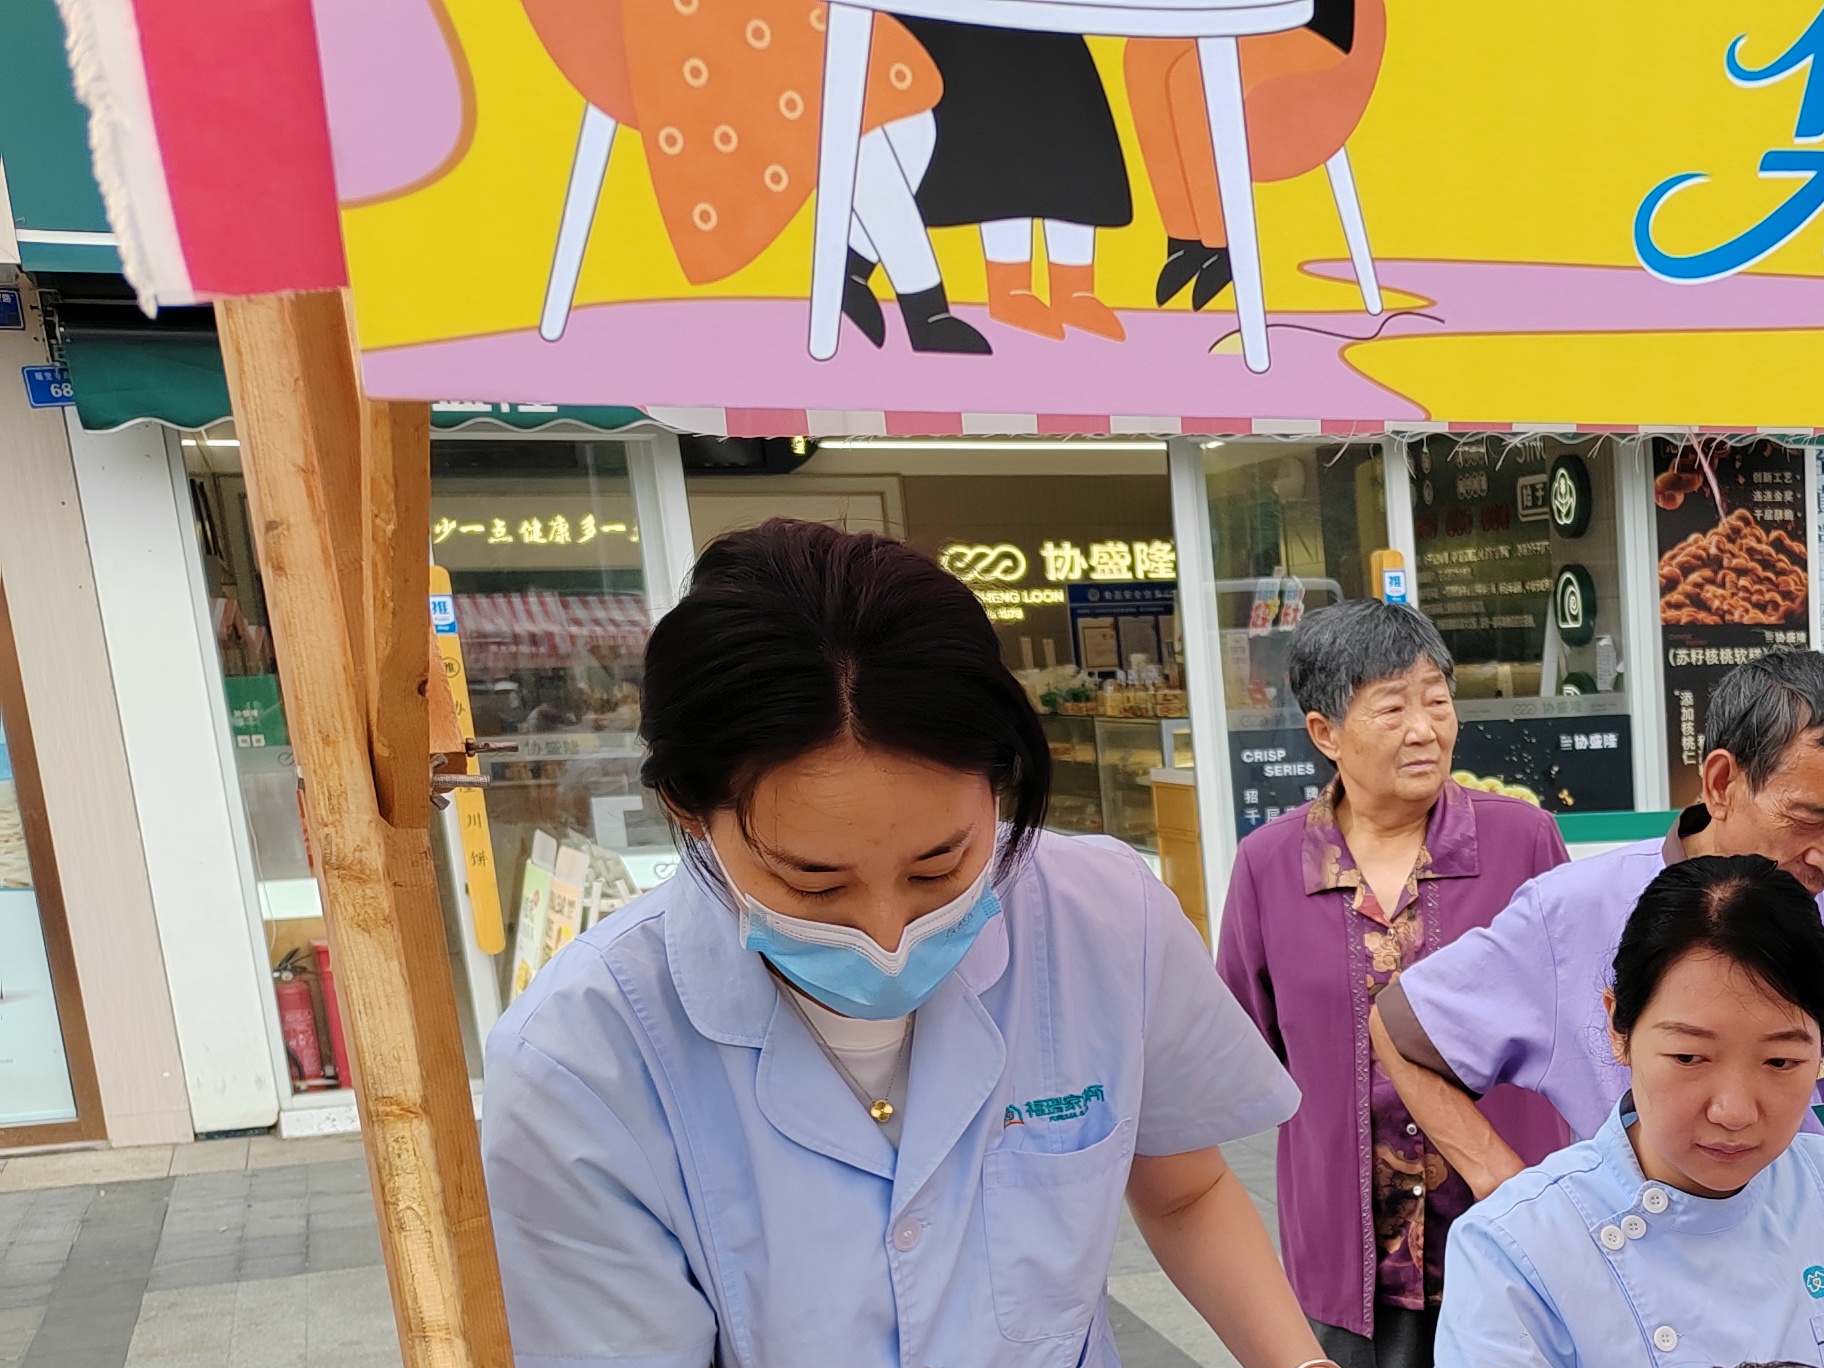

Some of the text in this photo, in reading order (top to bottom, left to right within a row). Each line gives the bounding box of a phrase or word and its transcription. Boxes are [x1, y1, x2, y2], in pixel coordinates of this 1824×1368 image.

[1040, 540, 1177, 581] 协盛隆
[976, 590, 1021, 604] HENG
[1241, 749, 1287, 763] CRISP
[1263, 762, 1316, 777] SERIES
